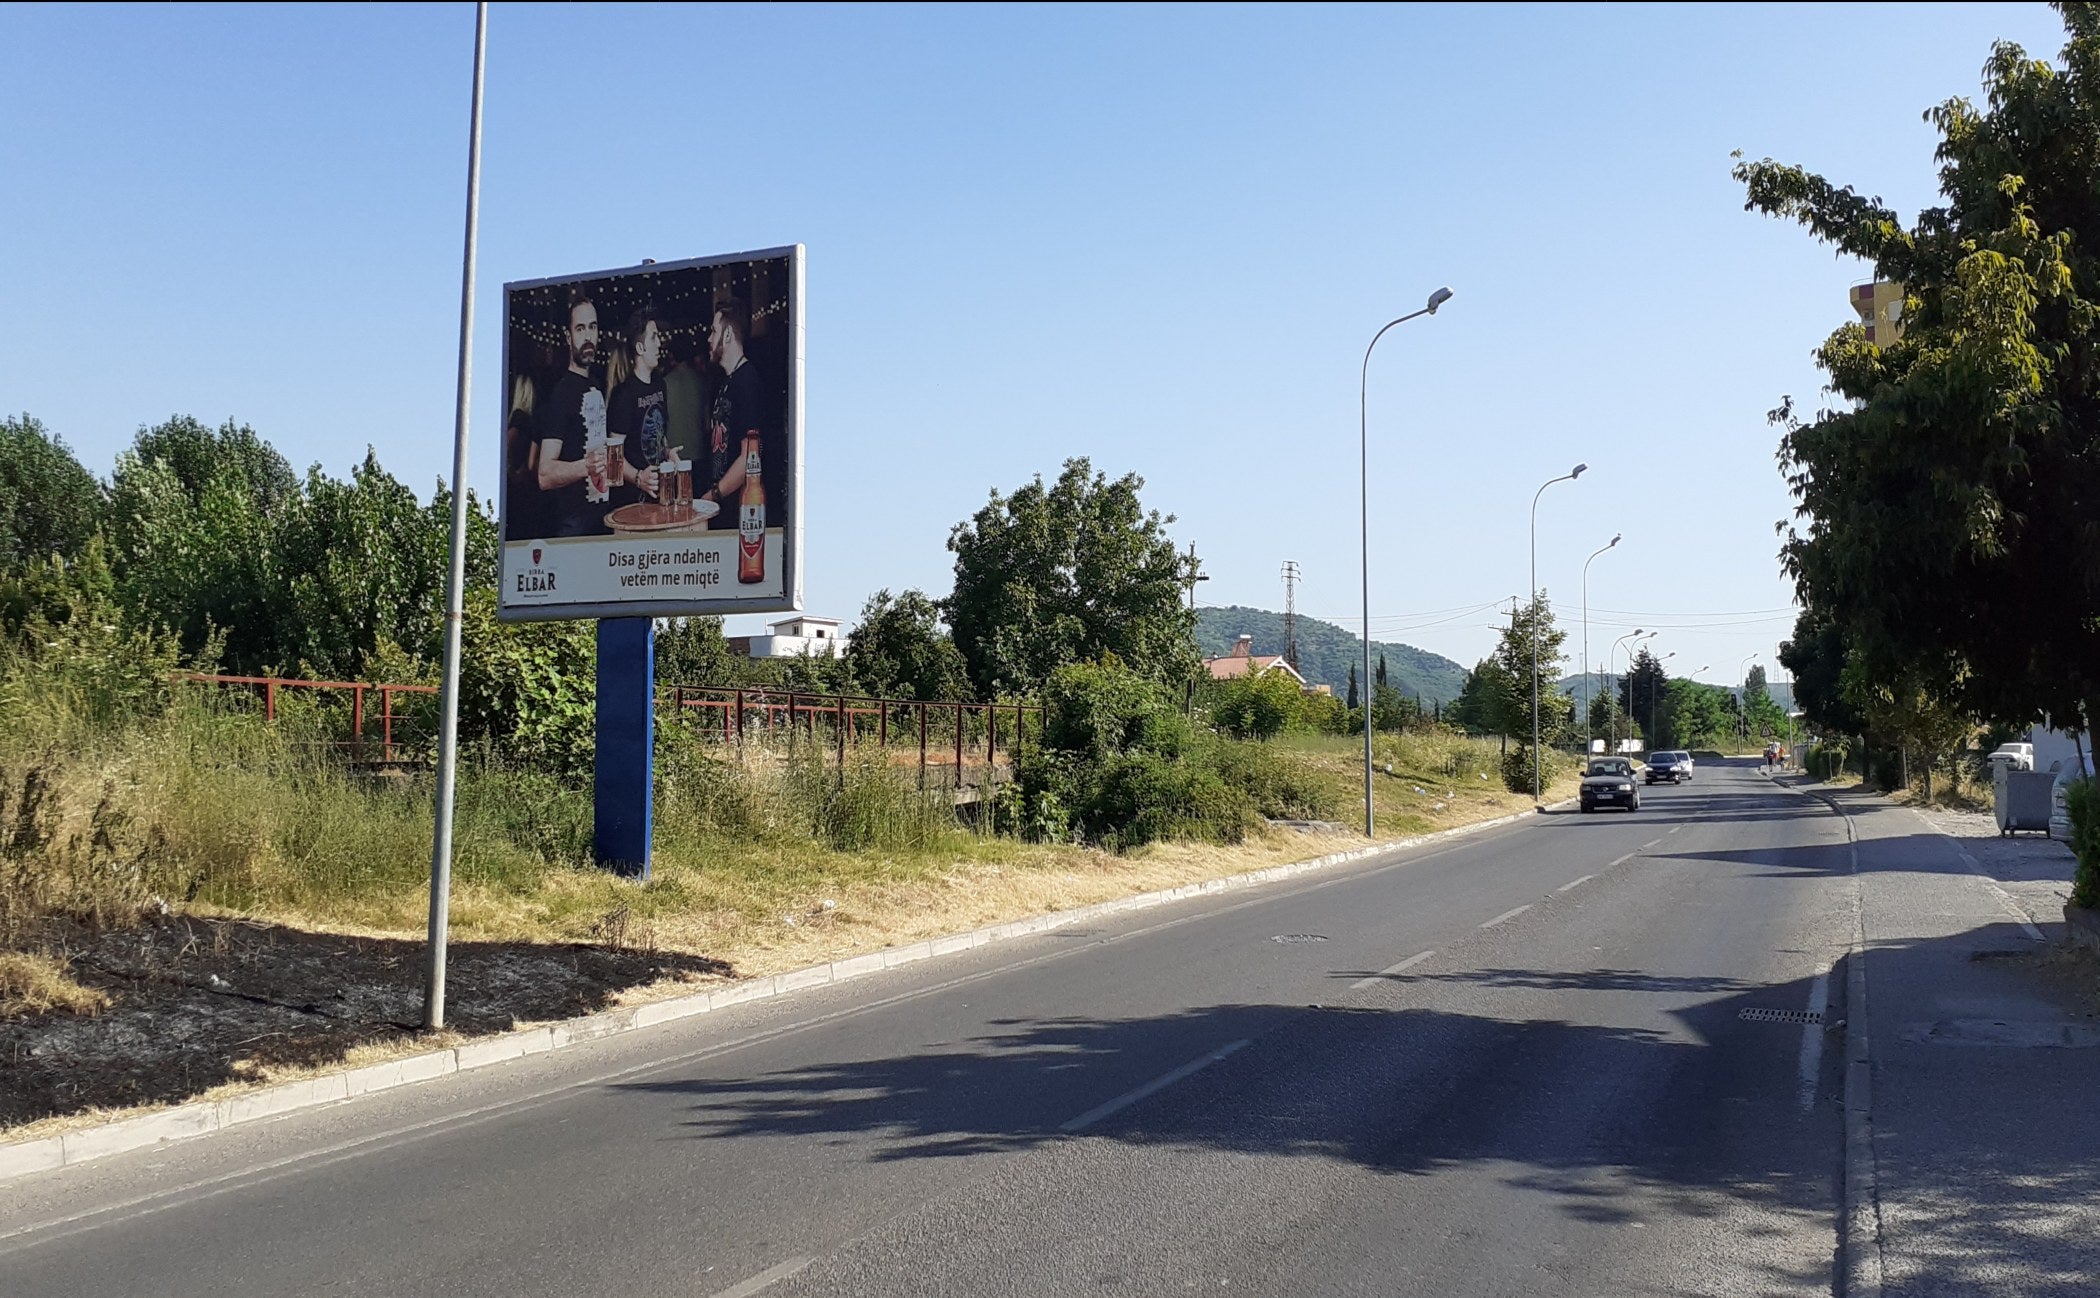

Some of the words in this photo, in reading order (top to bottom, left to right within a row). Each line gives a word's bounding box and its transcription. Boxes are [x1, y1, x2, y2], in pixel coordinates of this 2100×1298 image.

[742, 519, 763, 531] ELBAR
[608, 552, 635, 567] Disa
[637, 550, 671, 570] gjëra
[673, 548, 720, 565] ndahen
[516, 572, 557, 592] ELBAR
[620, 571, 658, 587] vetëm
[661, 573, 681, 586] me
[683, 569, 720, 589] miqtë
